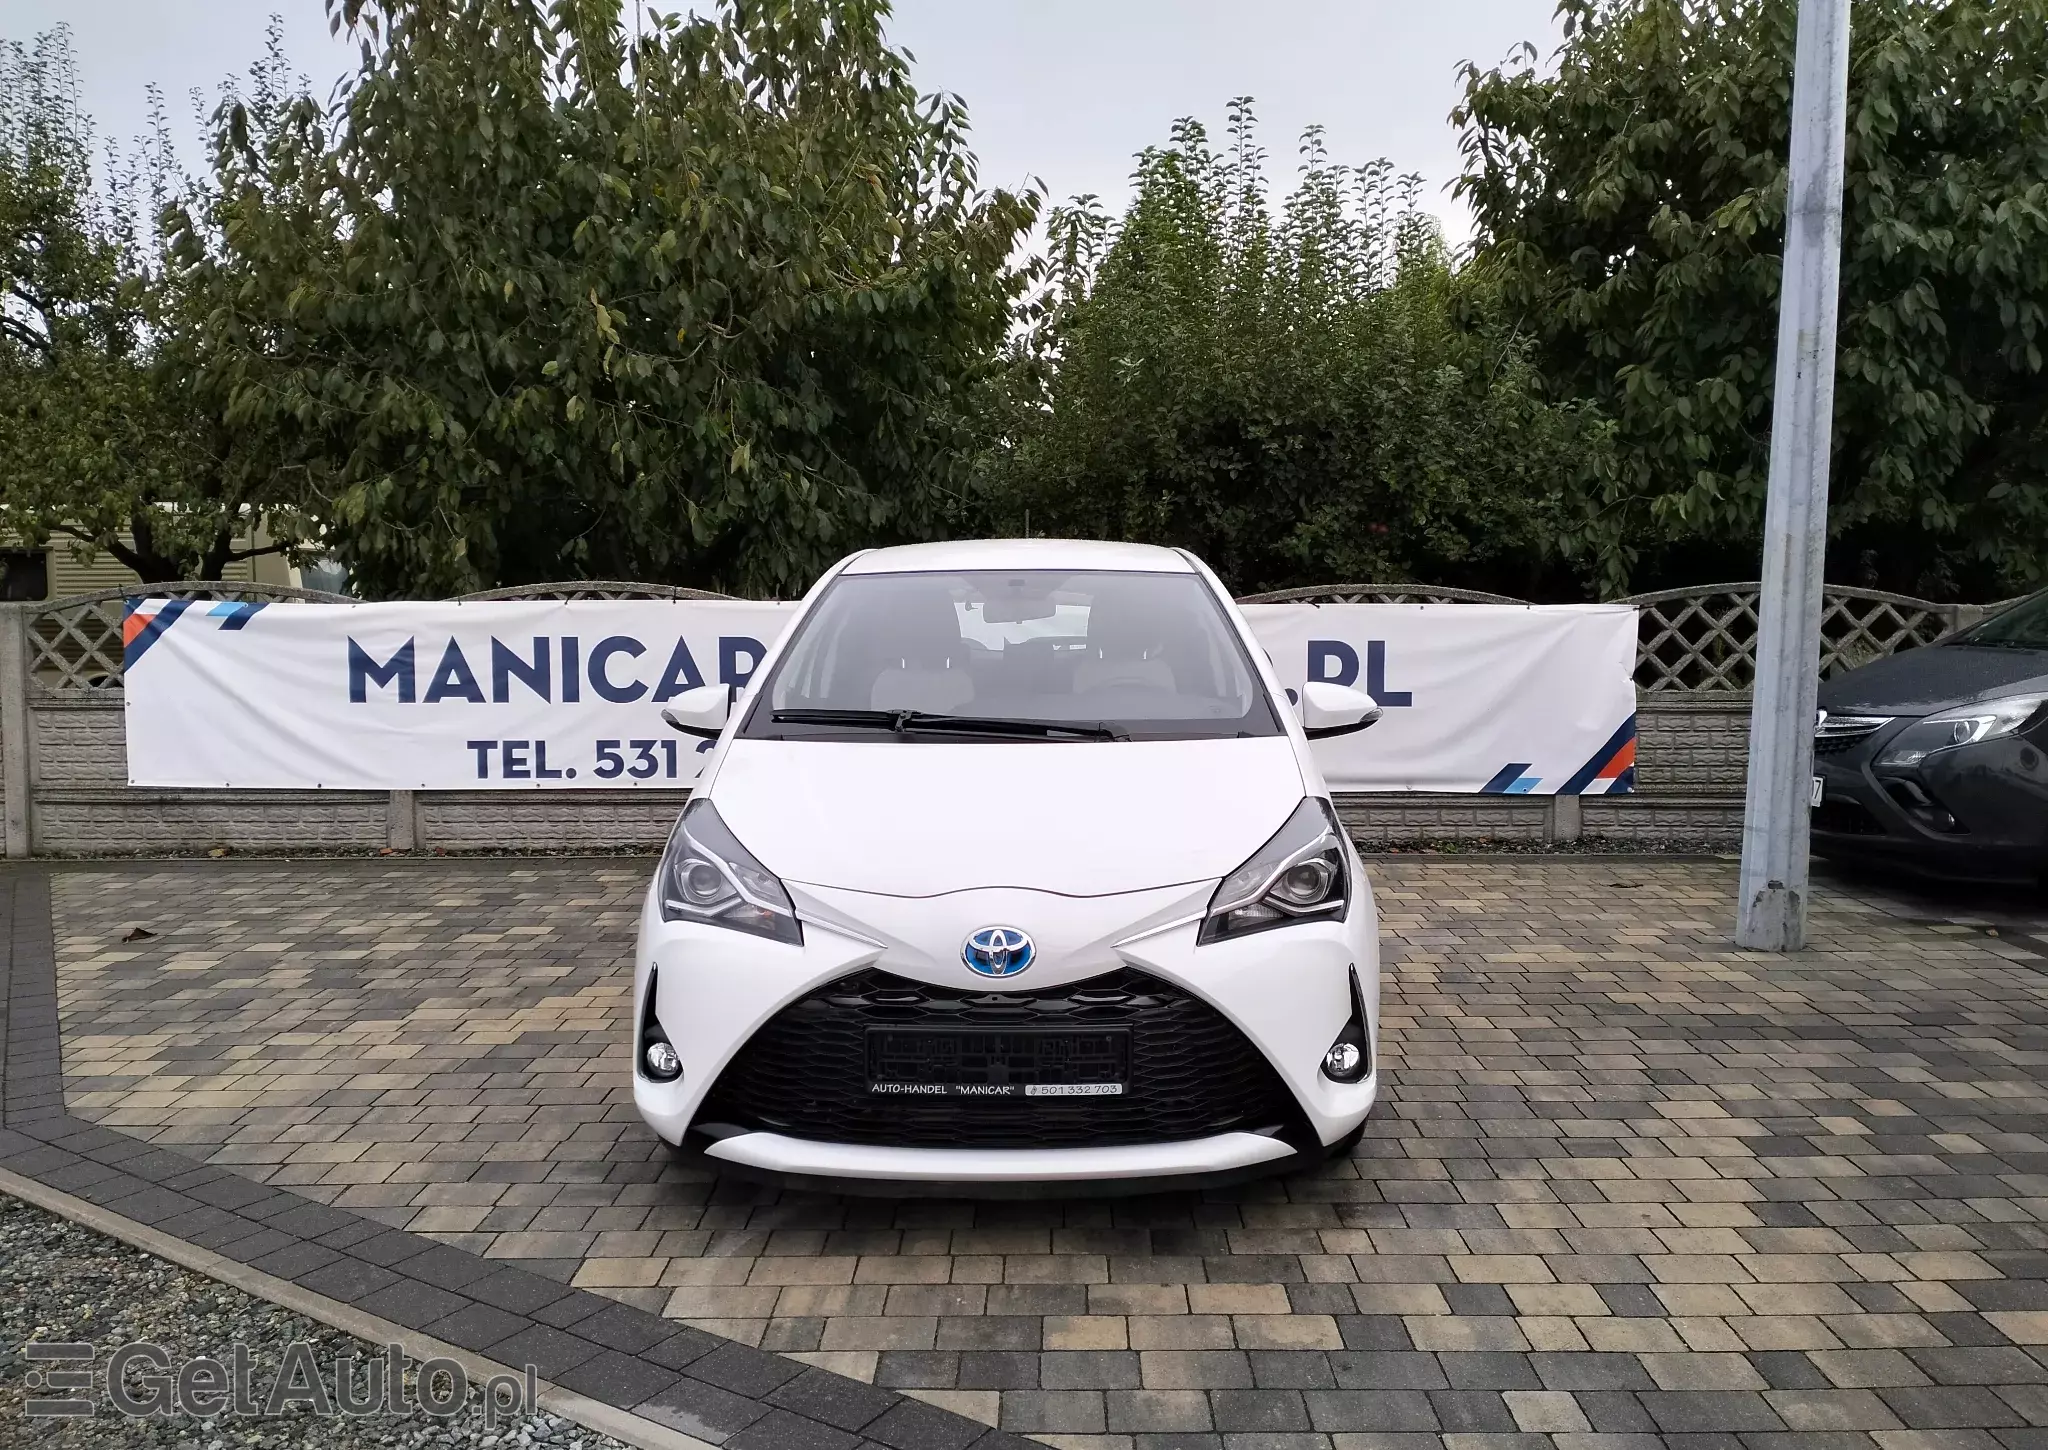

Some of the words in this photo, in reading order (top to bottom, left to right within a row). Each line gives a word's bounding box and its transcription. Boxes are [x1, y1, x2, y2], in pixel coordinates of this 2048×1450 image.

[1263, 640, 1413, 707] .PL
[467, 740, 577, 780] TEL.
[593, 739, 678, 780] 531
[871, 1083, 948, 1095] AUTO-HANDEL
[955, 1085, 1015, 1096] "MANICAR"
[1041, 1085, 1064, 1095] 501
[1067, 1085, 1091, 1094] 332
[1094, 1084, 1118, 1094] 703
